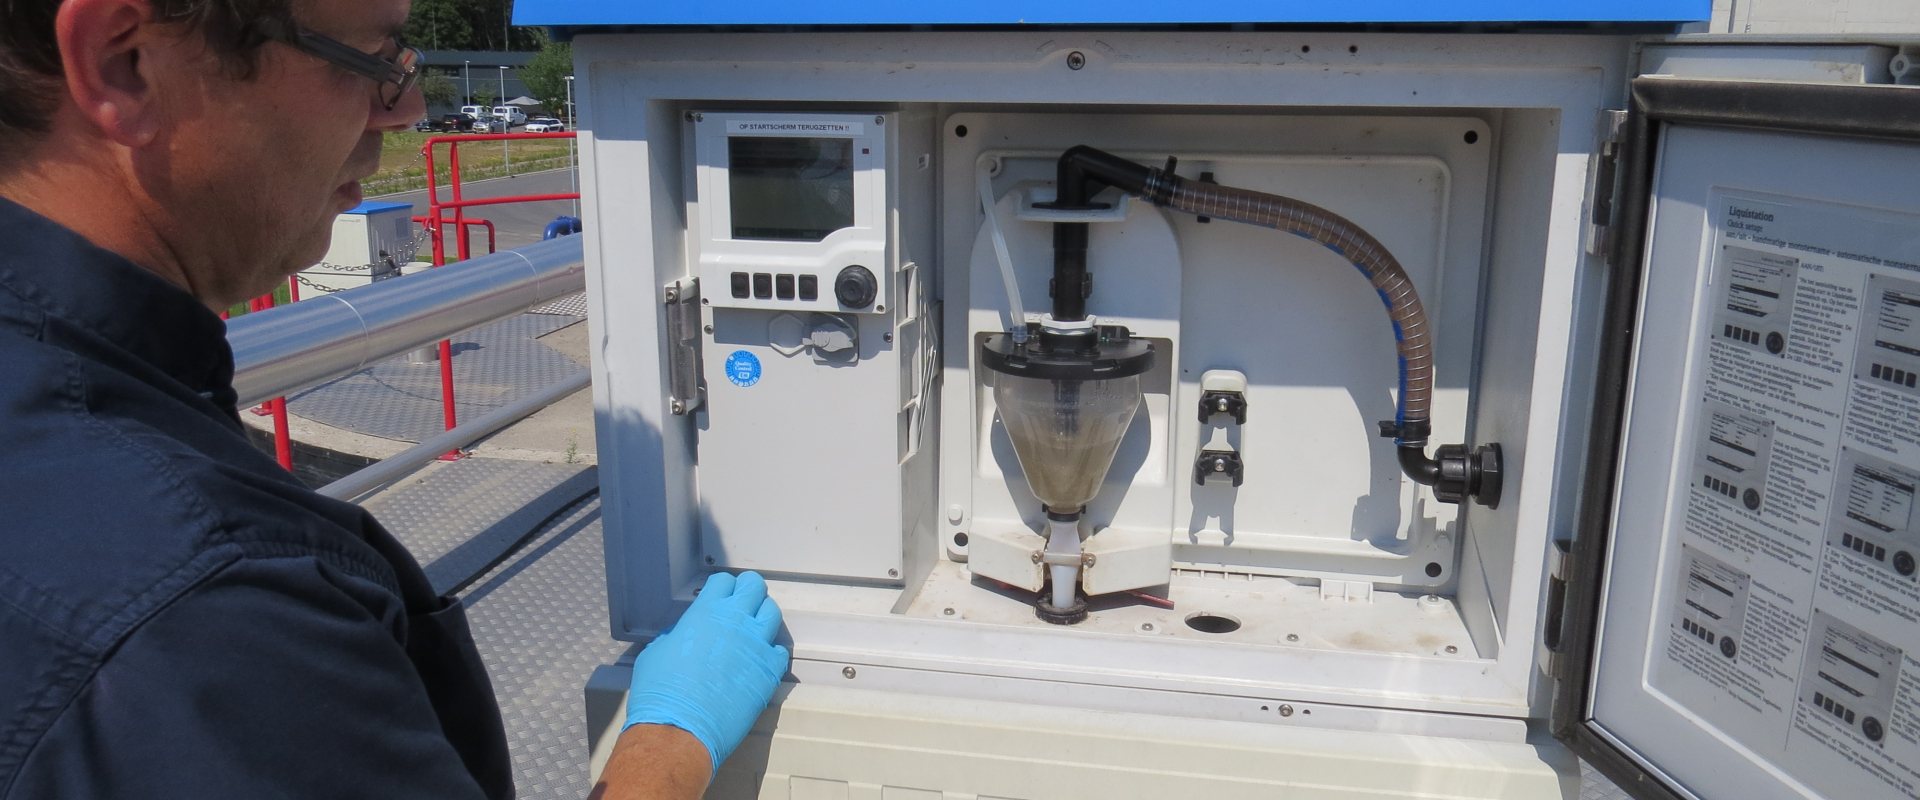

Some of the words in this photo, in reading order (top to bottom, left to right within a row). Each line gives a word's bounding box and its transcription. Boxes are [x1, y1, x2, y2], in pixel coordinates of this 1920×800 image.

[798, 124, 843, 132] TERUGZETTEN
[1729, 206, 1774, 222] Liquistation
[1727, 219, 1744, 229] Quick
